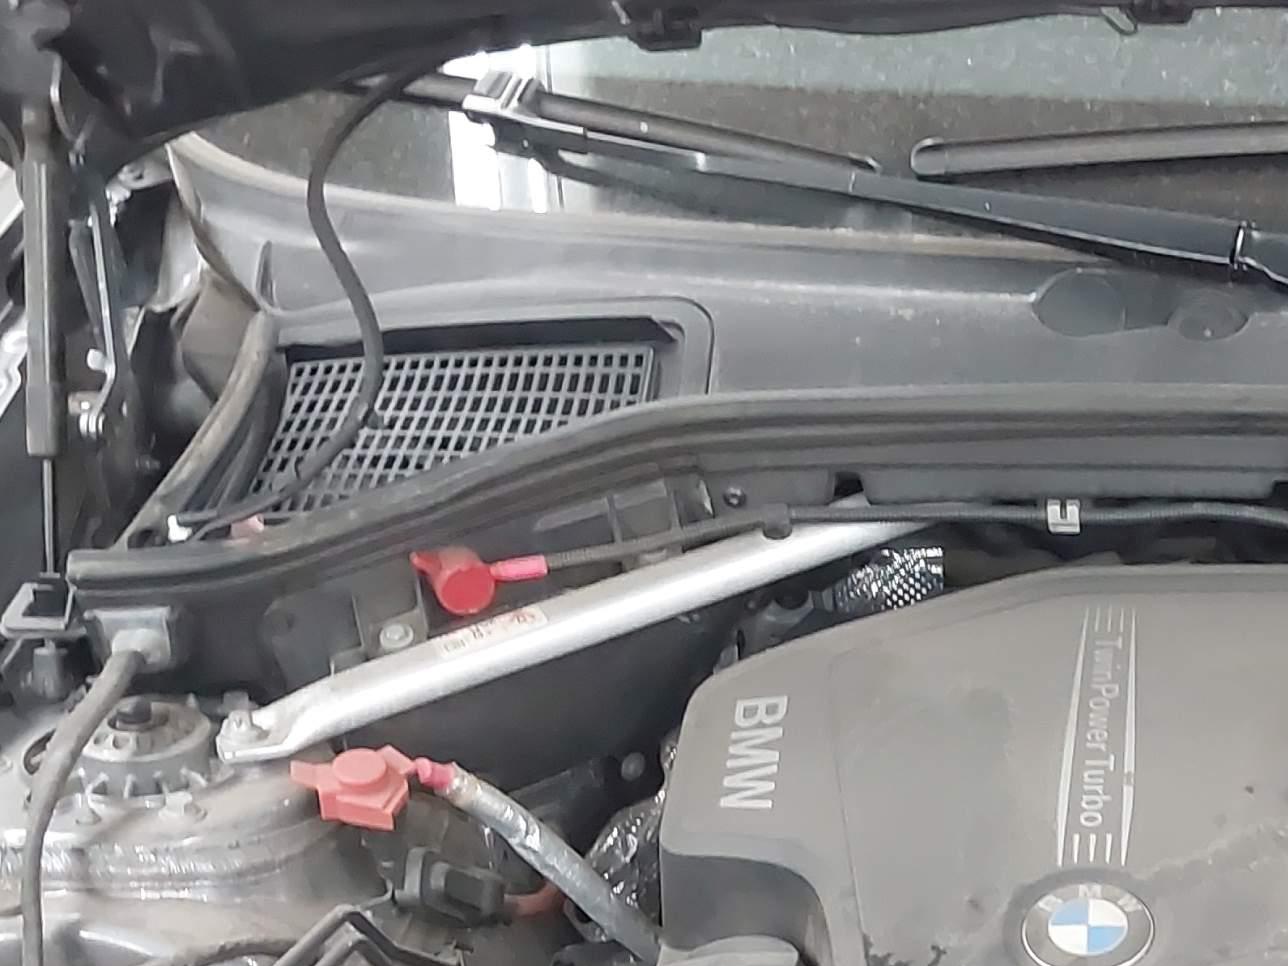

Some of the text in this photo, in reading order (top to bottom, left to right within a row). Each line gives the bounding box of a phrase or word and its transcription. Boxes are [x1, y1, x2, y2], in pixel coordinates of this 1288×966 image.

[719, 695, 789, 810] BMW
[1080, 635, 1122, 828] TwinPower Turbo
